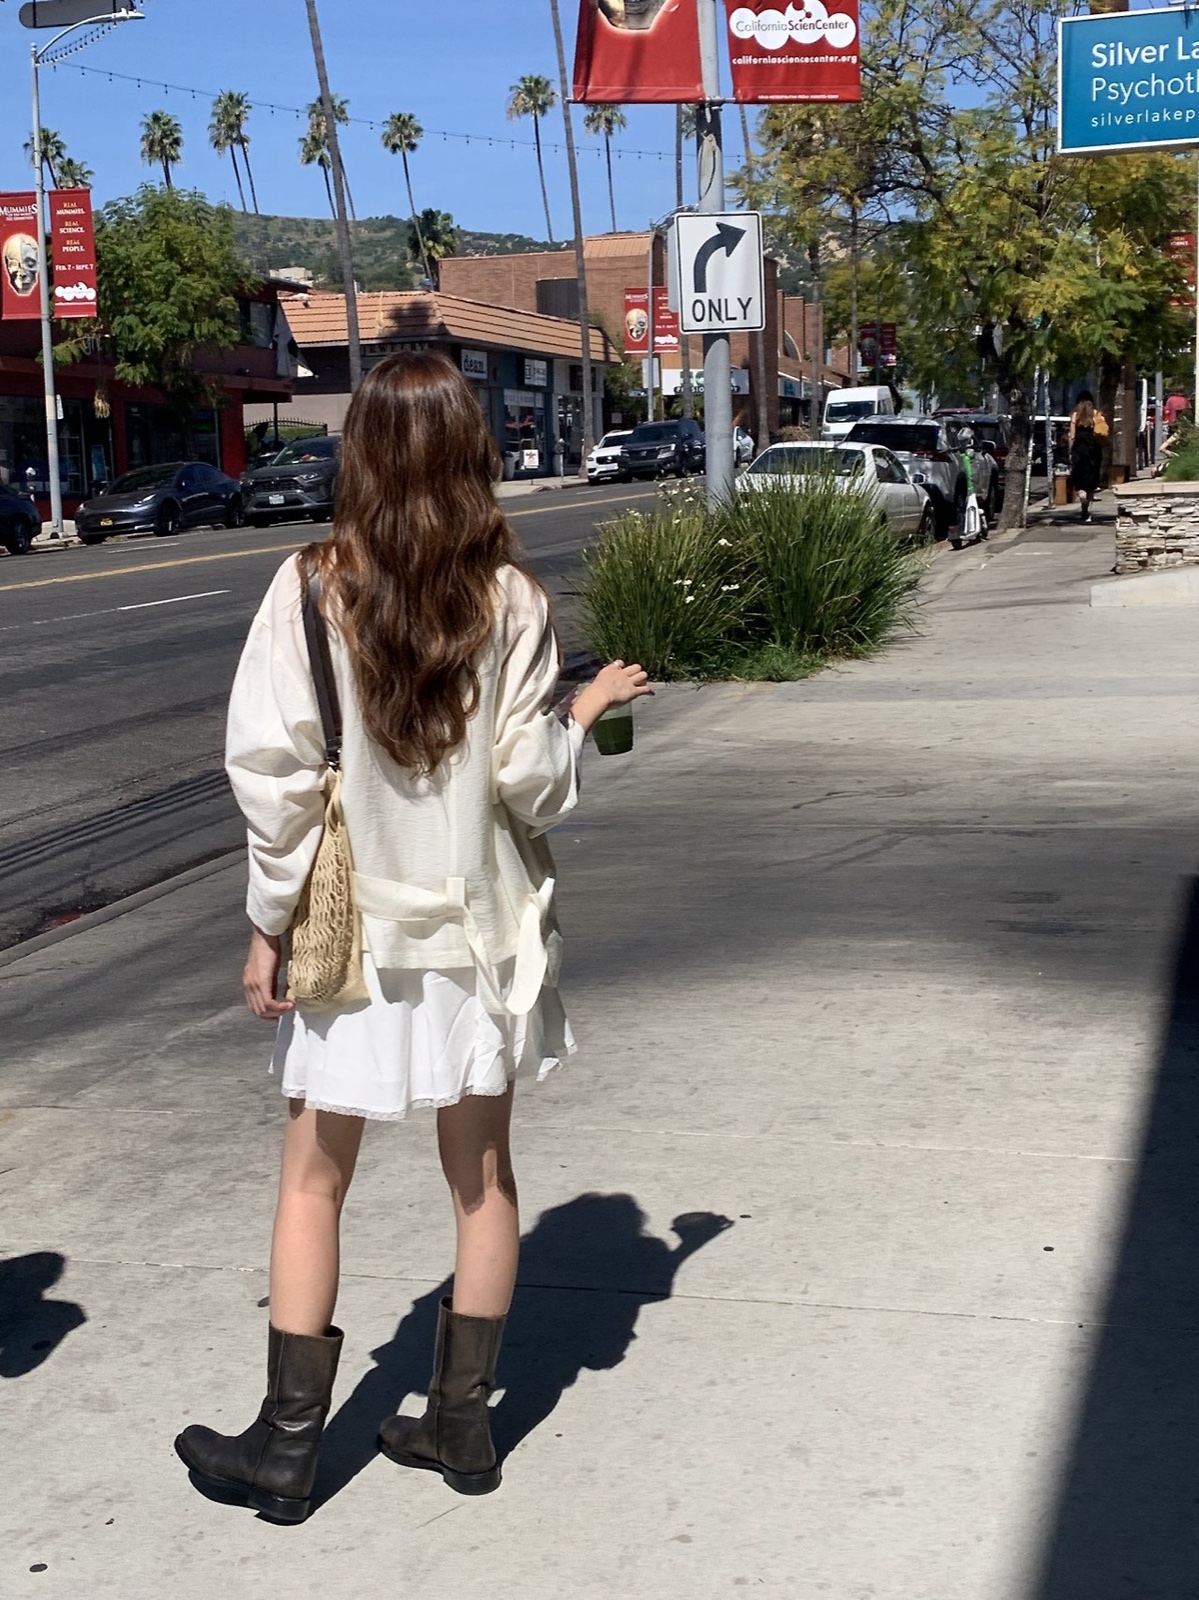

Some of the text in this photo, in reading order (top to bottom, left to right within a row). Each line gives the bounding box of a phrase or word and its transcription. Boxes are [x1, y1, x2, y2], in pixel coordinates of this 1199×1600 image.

[732, 55, 858, 64] californiasciencecenter.org
[1091, 41, 1170, 68] Silver
[1091, 107, 1199, 127] silverlakep
[692, 297, 753, 323] ONLY
